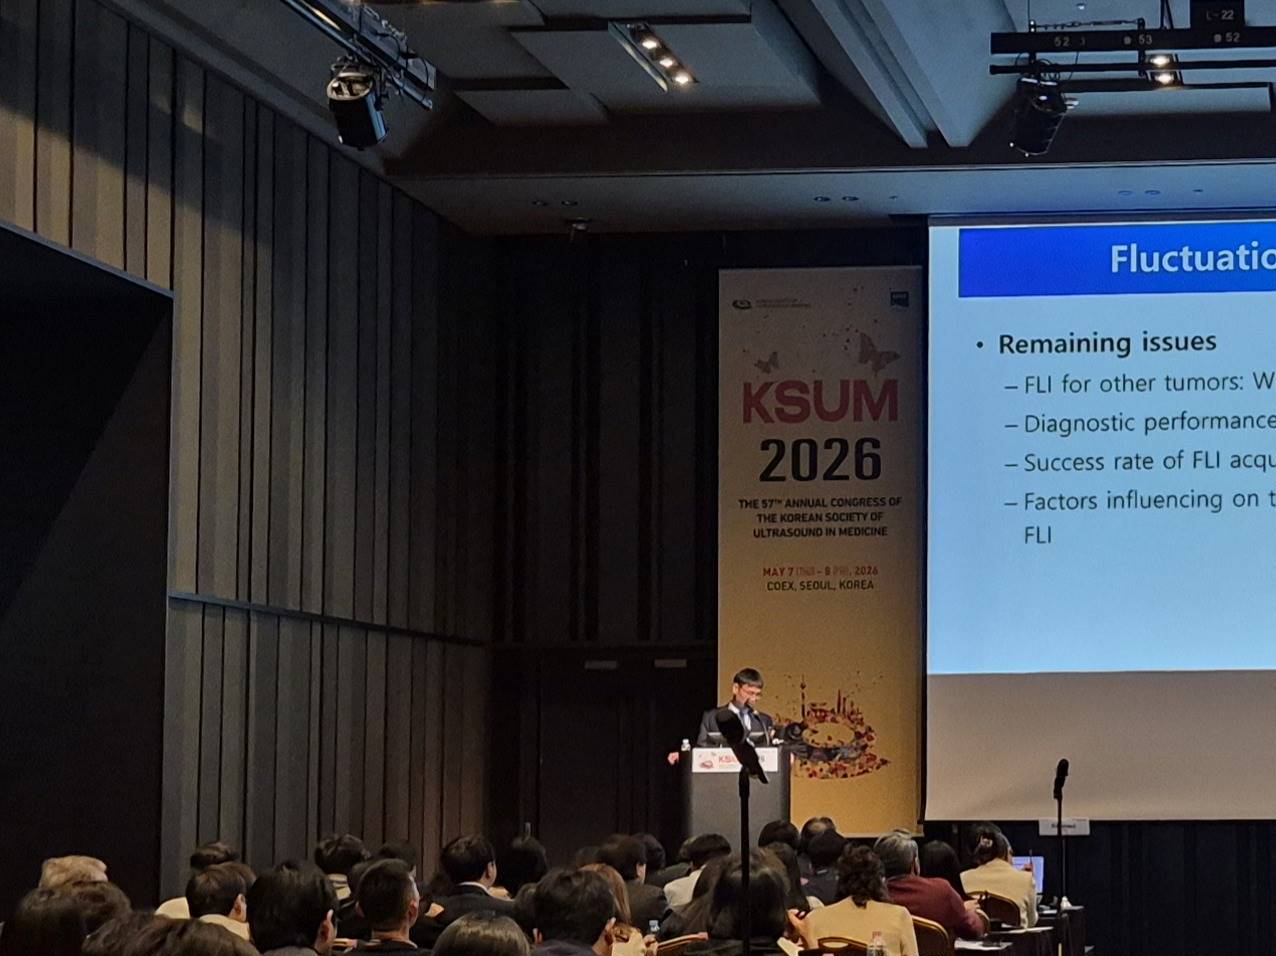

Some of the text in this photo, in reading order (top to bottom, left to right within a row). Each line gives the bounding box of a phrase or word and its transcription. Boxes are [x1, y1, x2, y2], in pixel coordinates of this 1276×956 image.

[1000, 331, 1216, 358] Remaining issues
[1026, 376, 1051, 393] FLI
[1063, 374, 1091, 393] for
[1100, 374, 1156, 392] other
[1165, 376, 1243, 391] tumors:
[742, 379, 898, 424] KSUM
[1025, 412, 1134, 437] Diagnostic
[759, 437, 881, 482] 2026
[1025, 454, 1104, 471] Success
[1115, 454, 1153, 470] rate
[1163, 450, 1184, 469] of
[1193, 451, 1219, 468] FLI
[739, 499, 762, 508] THE
[785, 498, 827, 508] ANNUAL
[830, 497, 886, 507] CONGRESS
[889, 497, 902, 505] OF
[1025, 492, 1097, 510] Factors
[1108, 489, 1222, 513] influencing
[1233, 493, 1258, 507] on
[757, 512, 883, 523] THE KOREAN SOCIETY OF
[753, 527, 887, 538] ULTRASOUND IN MEDICINE
[1025, 526, 1051, 544] FLI
[763, 568, 785, 576] MAY
[788, 567, 793, 576] 7
[855, 566, 878, 575] 2026
[767, 580, 874, 591] COEX, SEOUL, KOREA
